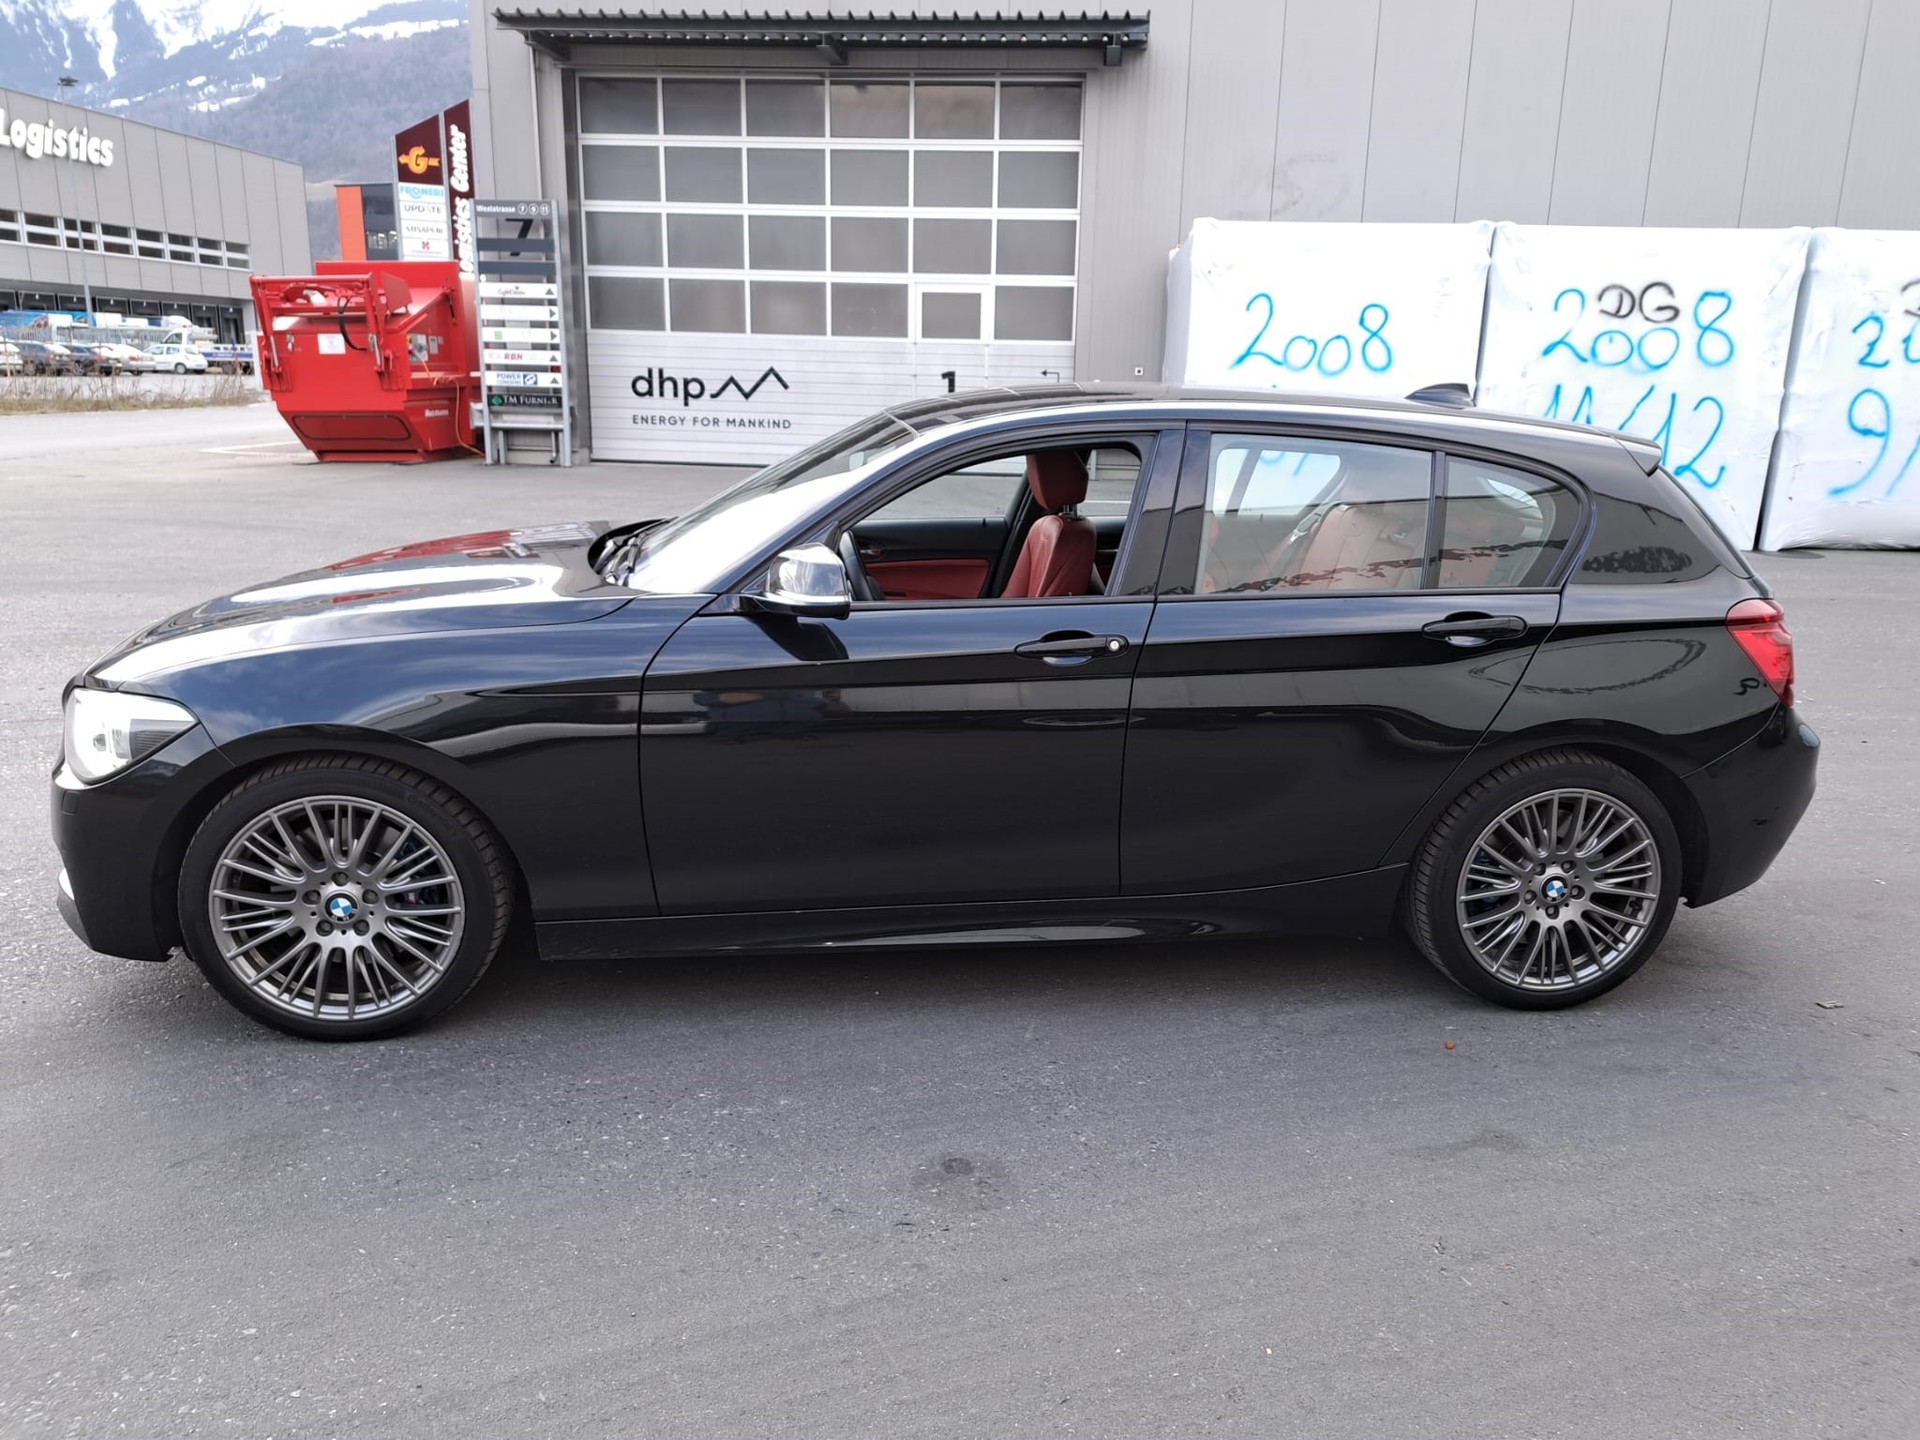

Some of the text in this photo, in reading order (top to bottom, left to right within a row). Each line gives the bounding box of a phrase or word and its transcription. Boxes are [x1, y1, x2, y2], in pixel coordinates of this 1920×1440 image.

[0, 107, 114, 167] Logistics
[448, 124, 475, 273] ogistics Center
[505, 218, 534, 257] 7
[1597, 281, 1681, 323] DG
[1228, 292, 1393, 377] 2008
[1542, 287, 1736, 374] 2008
[631, 367, 706, 407] dhp
[941, 370, 956, 393] 1
[632, 414, 792, 430] ENERGY FOR MANKIND
